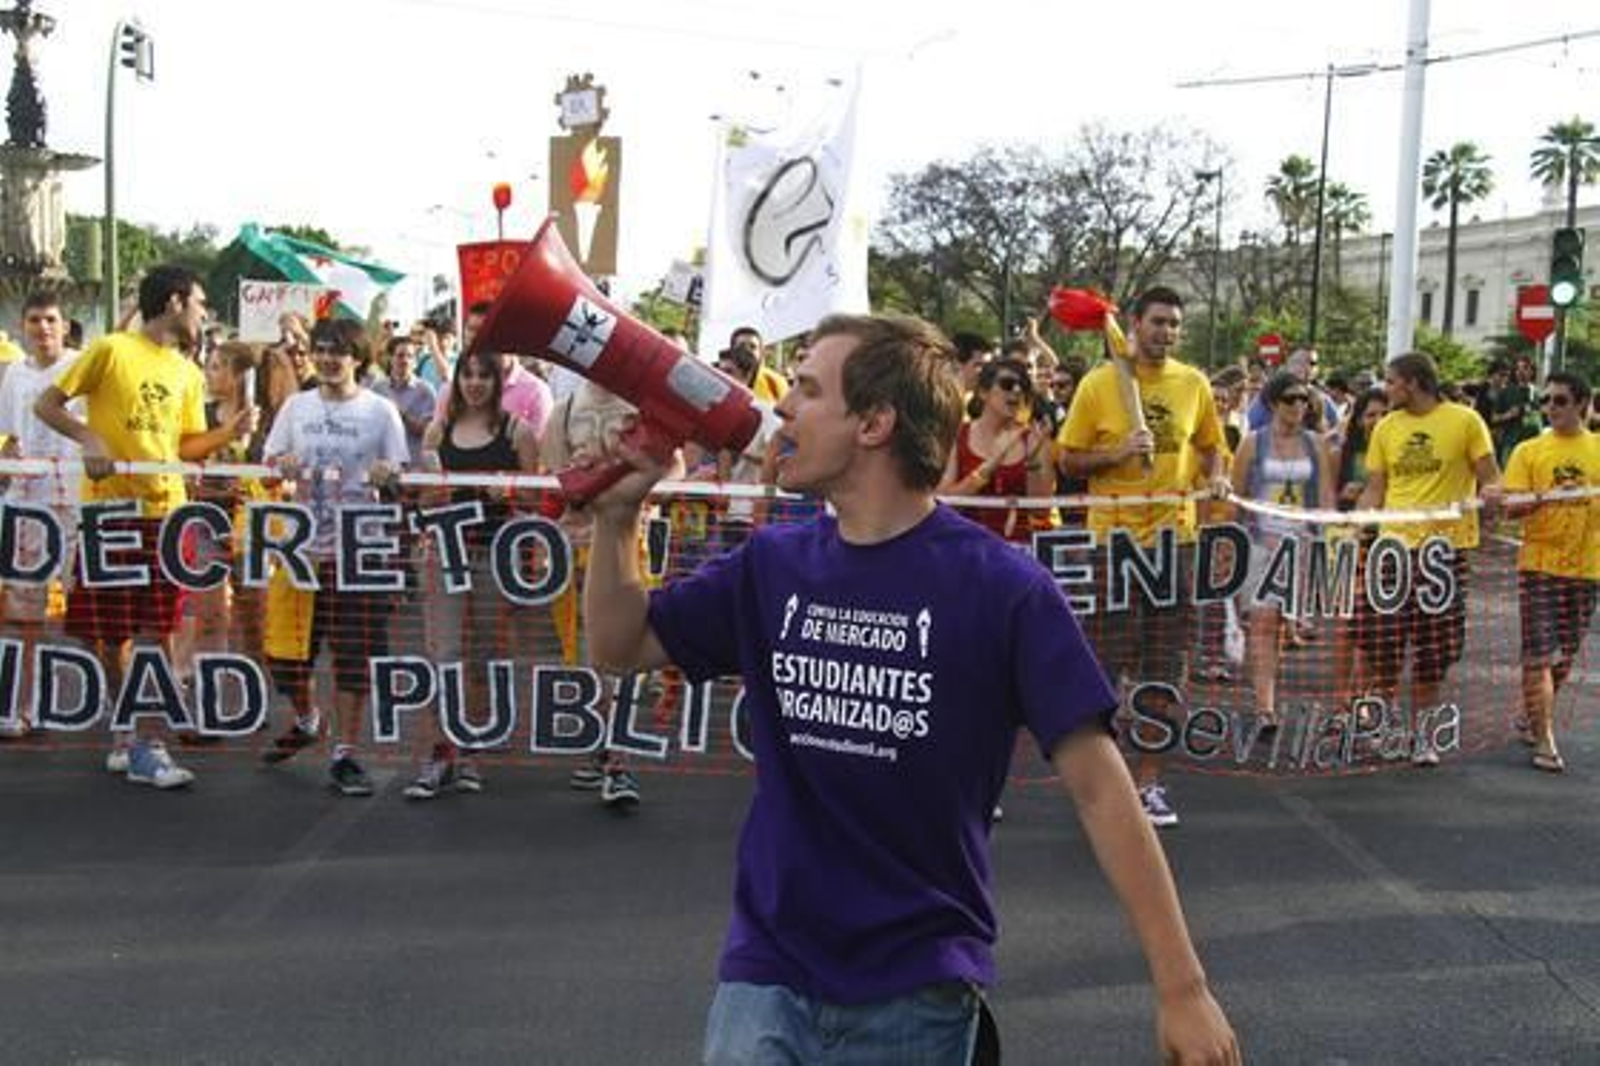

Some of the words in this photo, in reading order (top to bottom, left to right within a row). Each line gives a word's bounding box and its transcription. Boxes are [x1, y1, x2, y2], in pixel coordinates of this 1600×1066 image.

[0, 498, 572, 604] DECRETO
[801, 618, 823, 640] DE
[825, 621, 906, 651] MERCADO
[772, 652, 932, 703] ESTUDIANTES
[369, 656, 755, 761] PUBLI
[776, 687, 929, 739] RGANIZAD@S
